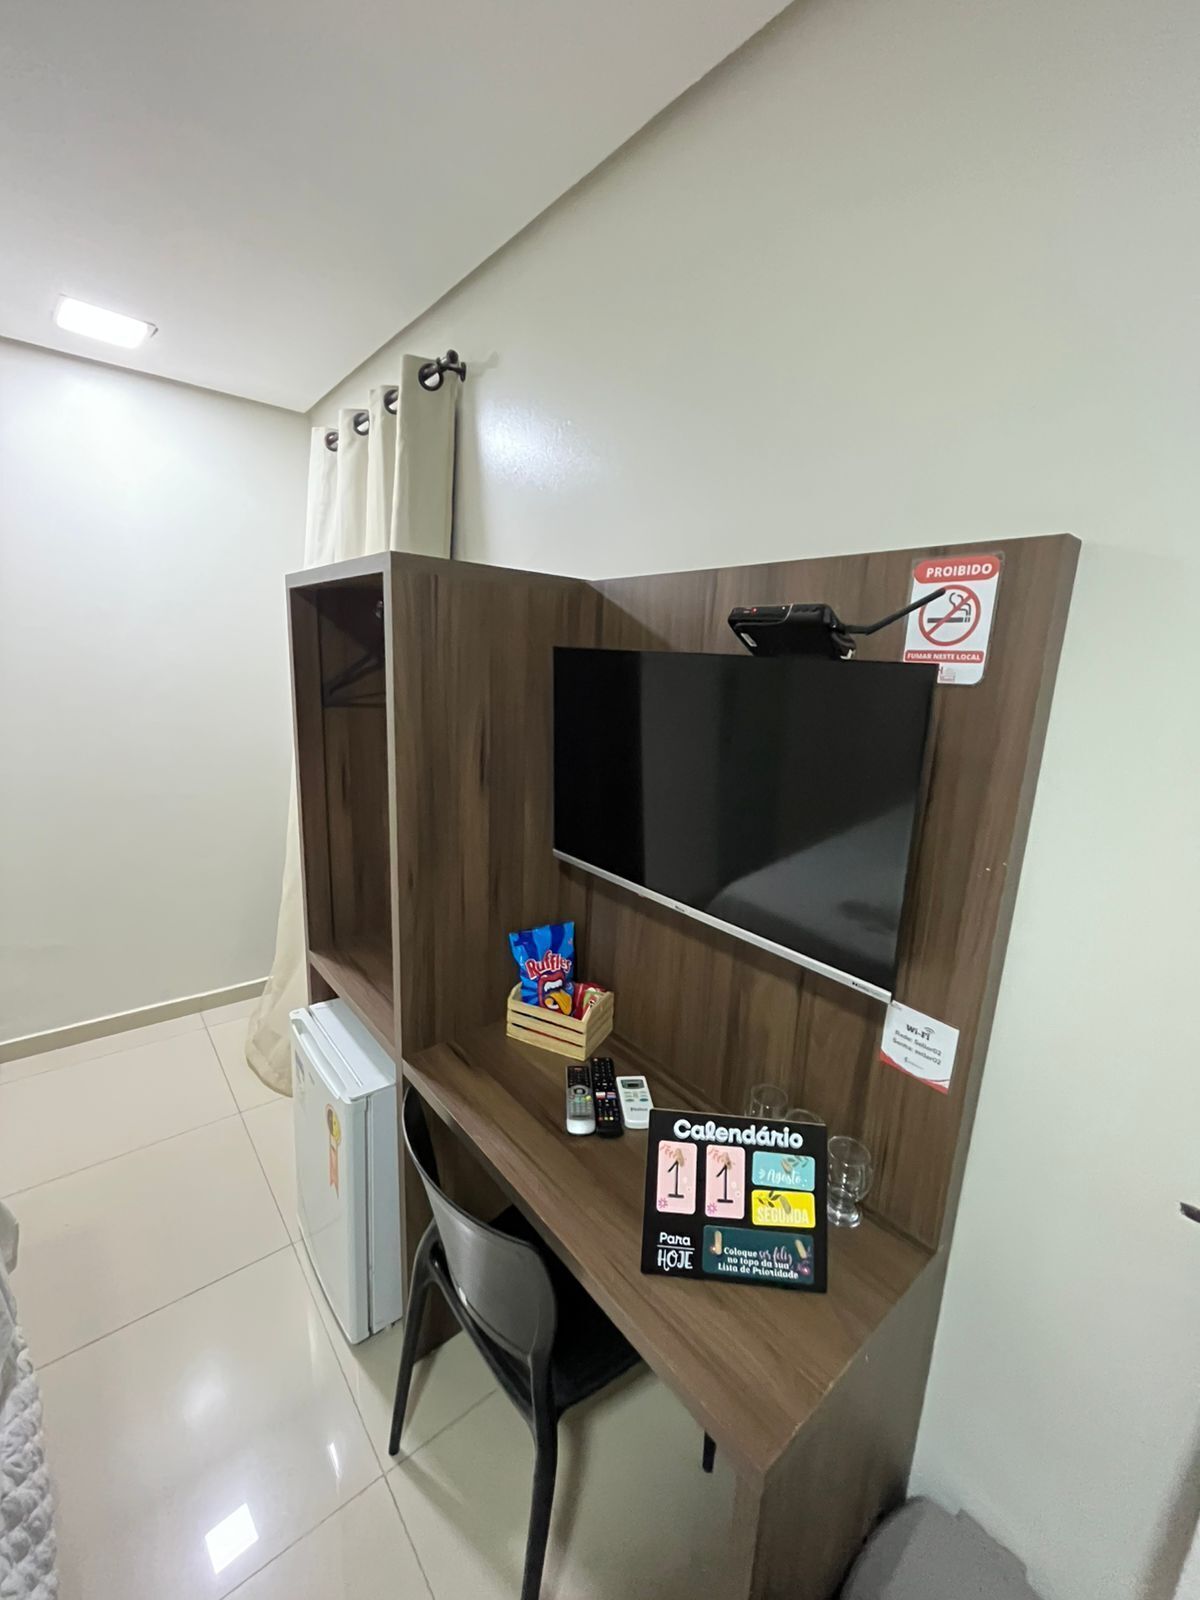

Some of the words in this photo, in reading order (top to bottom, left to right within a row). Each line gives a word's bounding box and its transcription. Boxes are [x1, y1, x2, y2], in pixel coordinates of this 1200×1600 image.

[926, 563, 993, 578] PROIBIDO
[907, 652, 931, 660] FUMAR
[956, 653, 981, 661] LOCAL
[525, 949, 572, 980] Ruffles
[673, 1119, 804, 1149] Calendário
[667, 1160, 684, 1199] 1
[716, 1165, 733, 1204] 1
[767, 1168, 803, 1185] Agosto
[659, 1231, 691, 1246] Para
[657, 1250, 693, 1271] HOJE
[724, 1246, 758, 1258] Coloque
[718, 1262, 738, 1273] Lista
[740, 1265, 751, 1274] de
[752, 1267, 799, 1280] Prioridade
[727, 1256, 738, 1264] no
[740, 1257, 759, 1267] topo
[761, 1259, 773, 1268] da
[775, 1261, 790, 1270] sua
